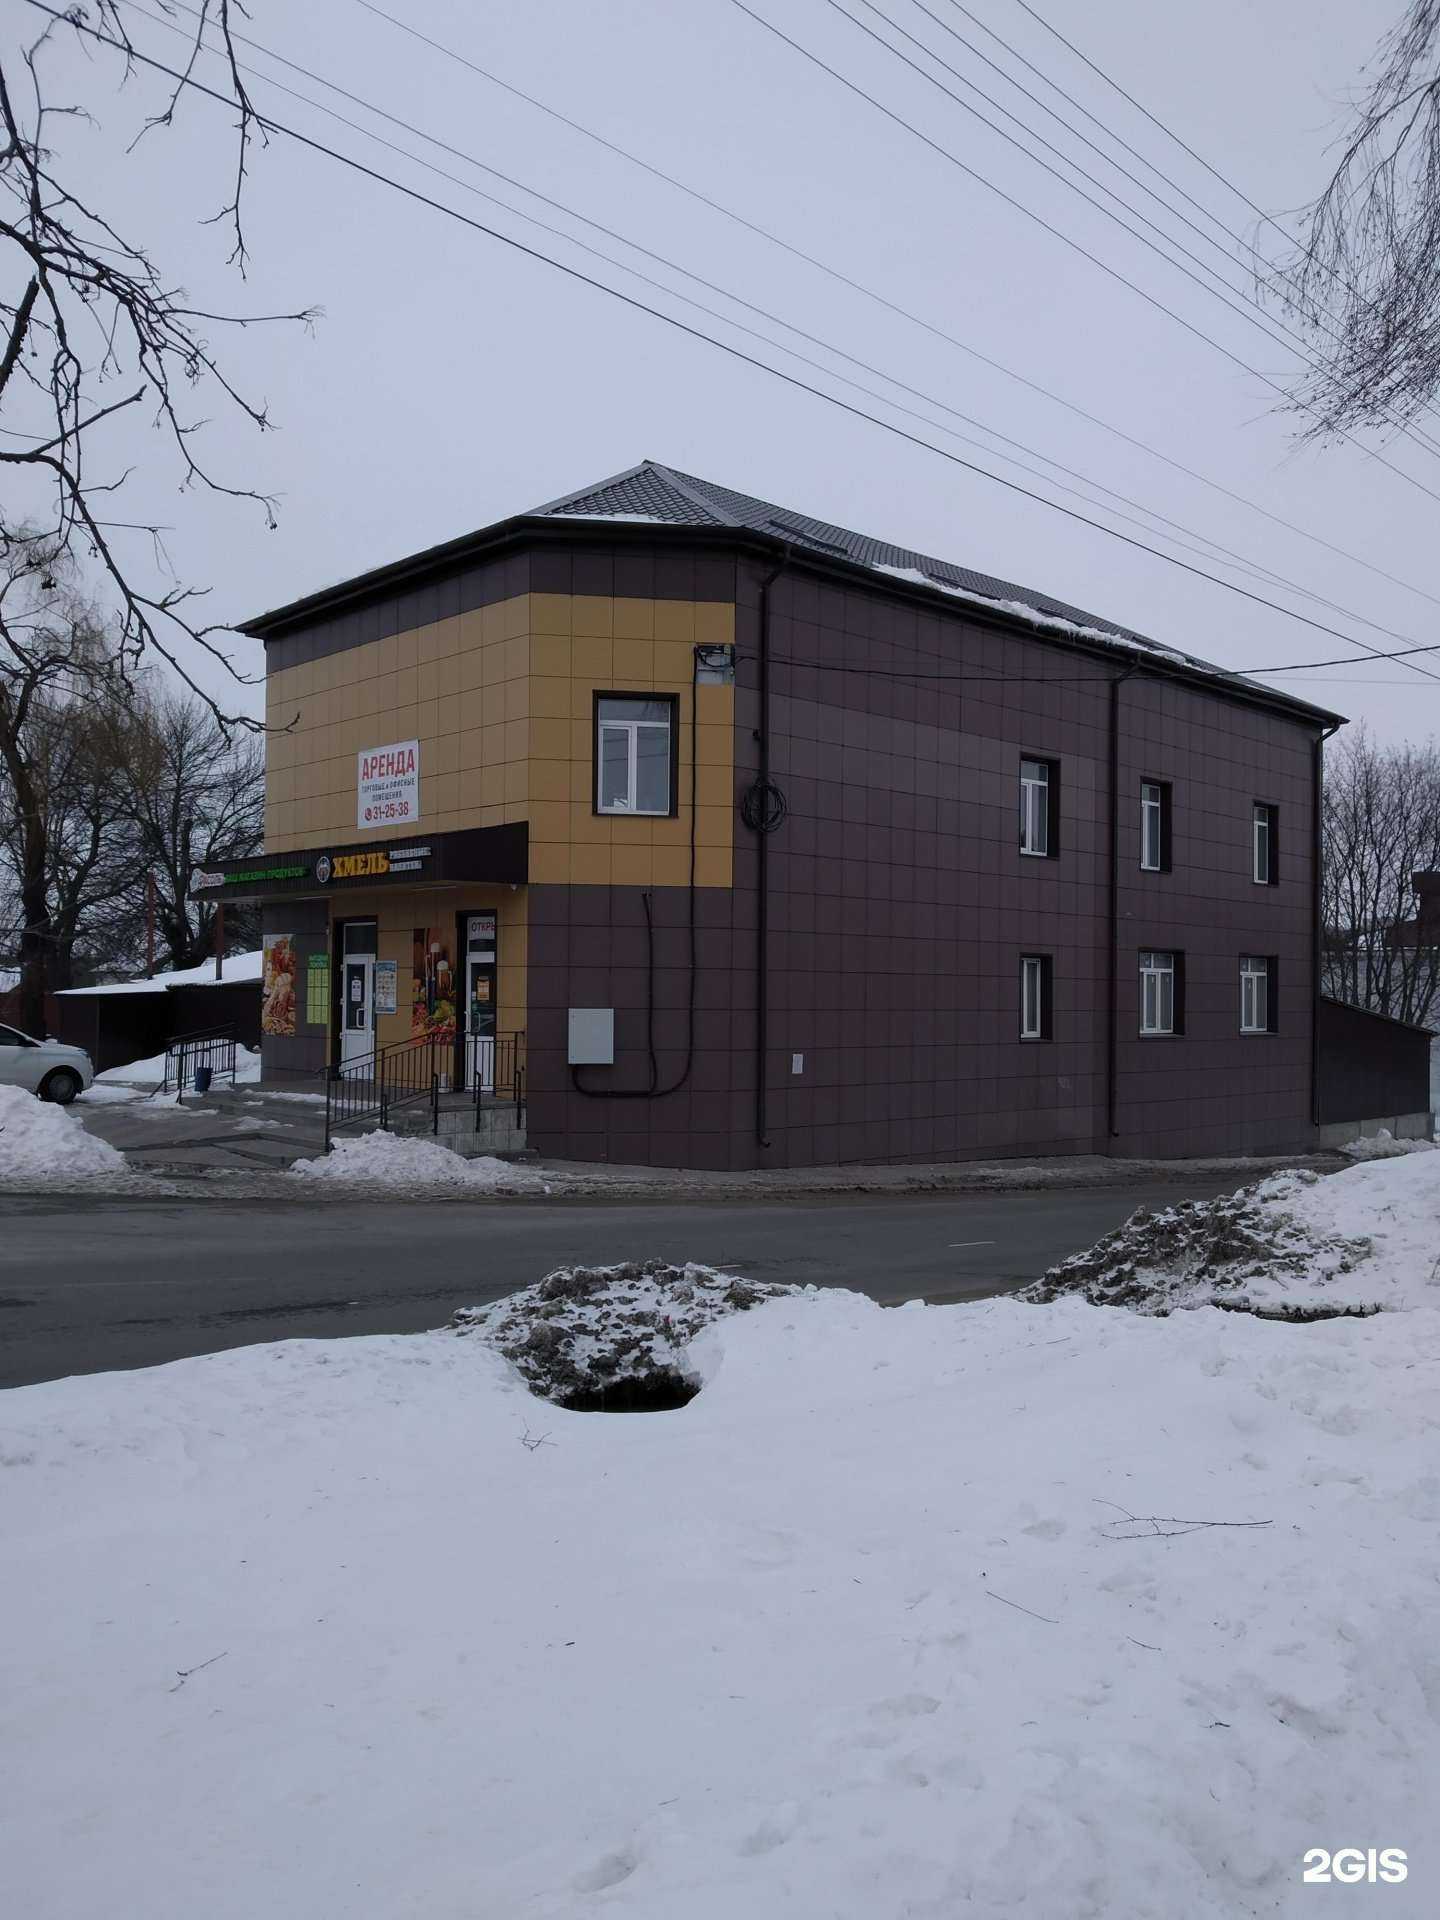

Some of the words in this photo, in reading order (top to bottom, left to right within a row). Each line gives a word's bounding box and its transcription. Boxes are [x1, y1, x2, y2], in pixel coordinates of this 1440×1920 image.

[362, 749, 415, 780] АРЕНДА
[373, 801, 409, 819] 31-25-38
[332, 852, 390, 878] ХМЕЛЬ
